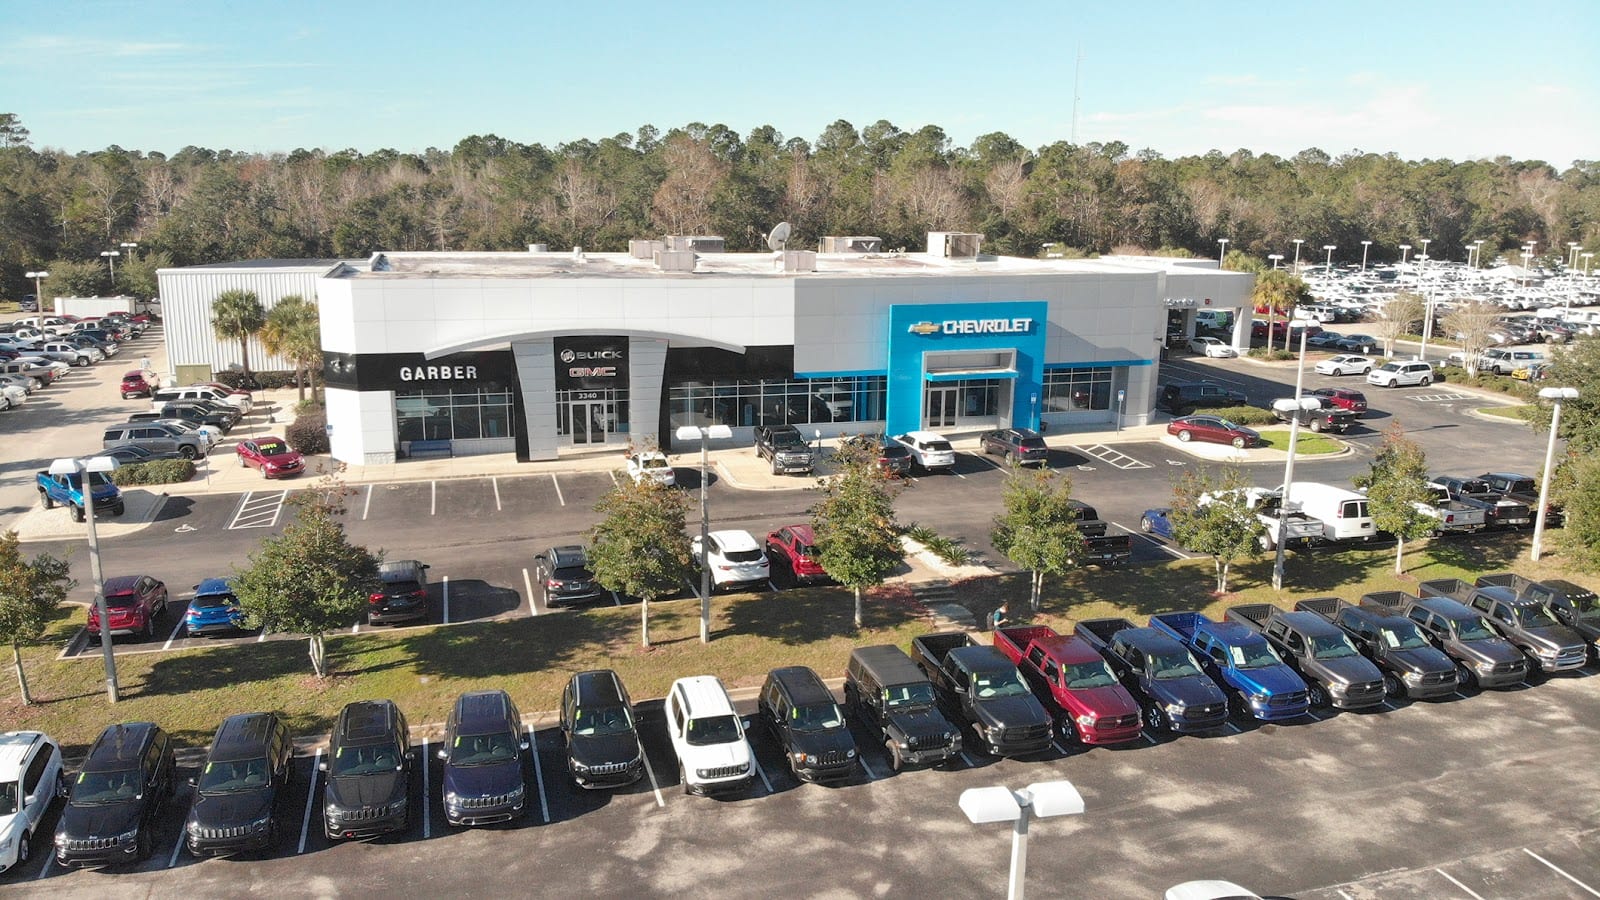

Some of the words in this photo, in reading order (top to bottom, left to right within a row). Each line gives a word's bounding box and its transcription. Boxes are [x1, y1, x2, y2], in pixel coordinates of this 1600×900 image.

[943, 318, 1032, 334] CHEVROLET
[576, 351, 623, 360] BUICK
[400, 365, 477, 381] GARBER
[569, 367, 616, 377] GMC
